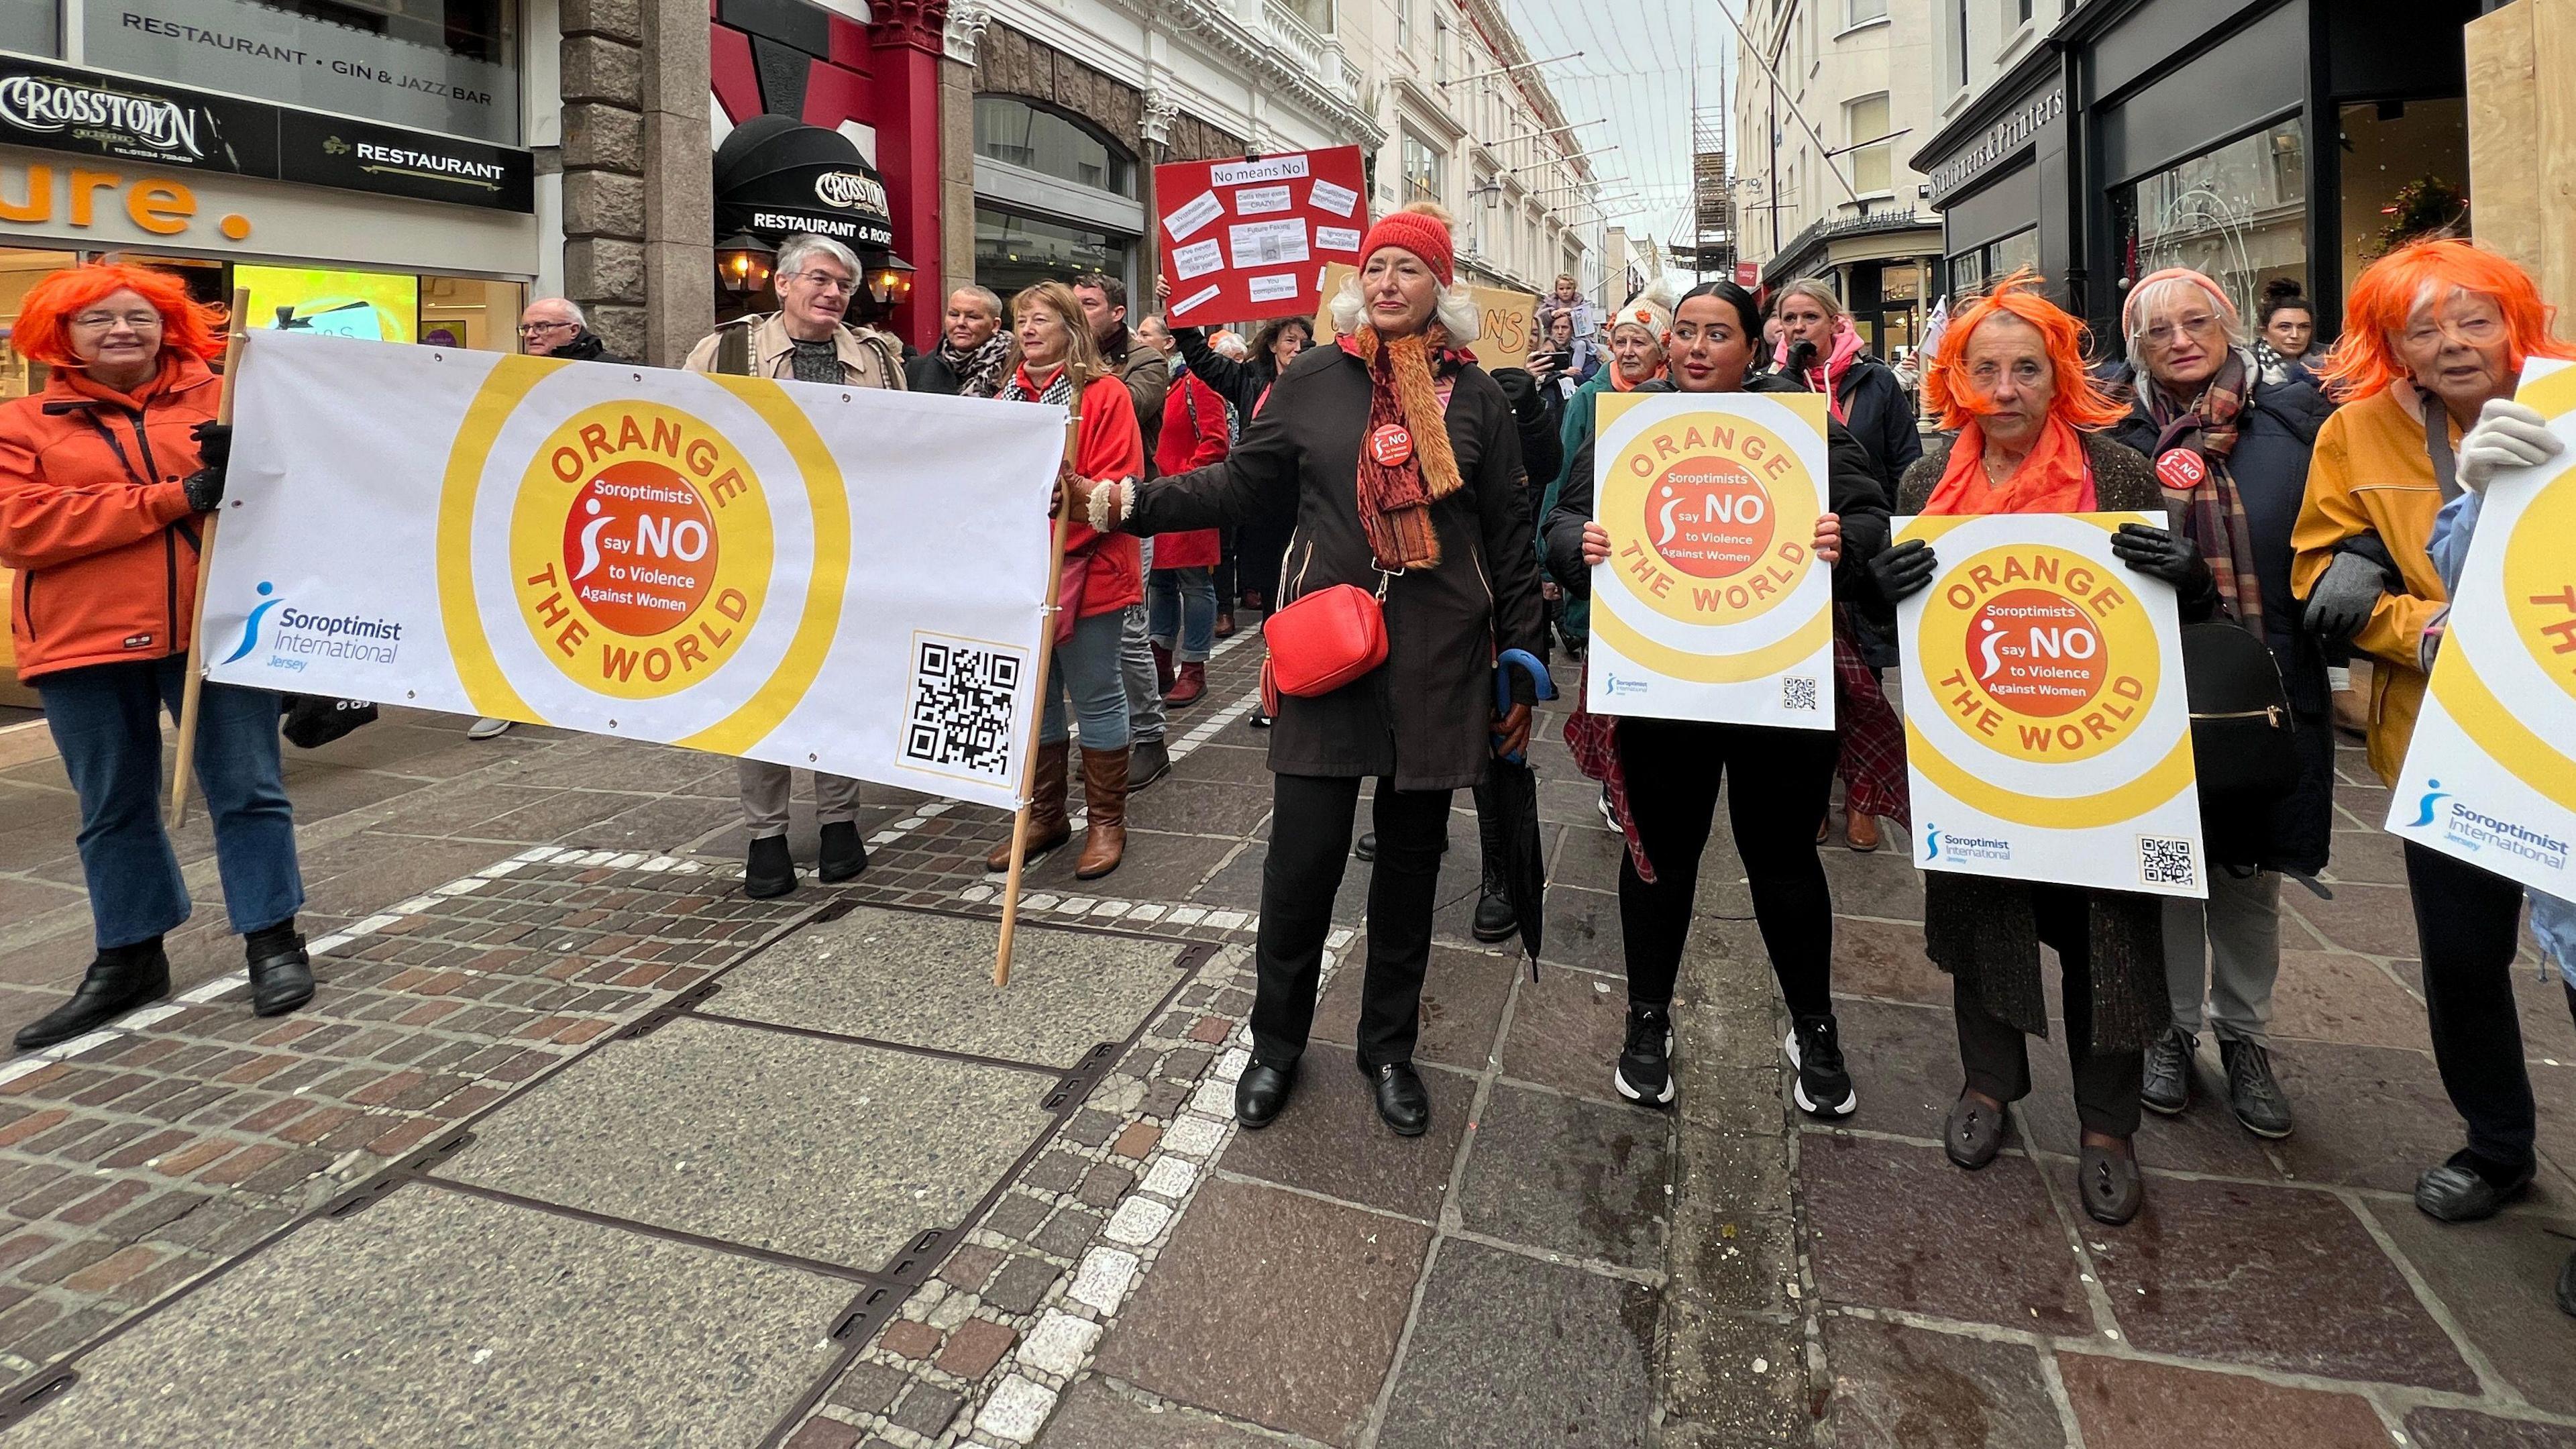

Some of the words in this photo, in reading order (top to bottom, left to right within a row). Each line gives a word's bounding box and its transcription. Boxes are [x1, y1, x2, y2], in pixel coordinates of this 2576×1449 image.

[123, 13, 307, 66] RESTAURANT
[332, 61, 372, 80] GIN
[378, 70, 392, 84] &
[396, 75, 447, 97] JAZZ
[452, 87, 492, 106] BAR
[0, 76, 204, 159] CROSSTOWN
[1931, 144, 1986, 199] Stationers
[1986, 131, 1998, 162] &
[1996, 88, 2064, 156] Printers
[357, 144, 504, 180] RESTAURANT
[1215, 170, 1233, 183] No
[1236, 168, 1279, 180] means
[1282, 161, 1306, 175] No!
[754, 213, 857, 237] RESTAURANT
[859, 226, 869, 239] &
[1173, 203, 1218, 235] communication
[1175, 201, 1205, 222] Withholds
[1388, 432, 1408, 446] NO
[1629, 426, 1792, 481] ORANGE
[551, 415, 747, 508] ORANGE
[2178, 462, 2200, 480] NO
[594, 479, 693, 505] Soroptimists
[1667, 472, 1750, 486] Soroptimists
[1678, 512, 1700, 524] say
[1705, 493, 1765, 525] NO
[604, 537, 632, 554] say
[636, 514, 709, 562] NO
[1685, 532, 1699, 542] to
[1701, 532, 1754, 545] Violence
[1661, 547, 1704, 559] Against
[1706, 550, 1752, 563] Women
[608, 564, 626, 580] to
[629, 565, 696, 589] Violence
[1620, 539, 1676, 599] THE
[1692, 541, 1805, 612] WORLD
[1947, 555, 2125, 618] ORANGE
[580, 585, 633, 604] Against
[636, 592, 687, 612] Women
[1986, 605, 2077, 619] Soroptimists
[279, 607, 403, 641] Soroptimist
[528, 562, 589, 658] THE
[602, 588, 747, 683] WORLD
[273, 630, 398, 664] International
[2001, 645, 2027, 658] say
[2030, 626, 2097, 660] NO
[266, 655, 309, 672] Jersey
[2010, 665, 2027, 678] to
[2027, 665, 2090, 680] Violence
[1988, 682, 2036, 696] Against
[2038, 684, 2088, 697] Women
[1939, 668, 2004, 737] THE
[2017, 676, 2143, 752] WORLD
[1945, 835, 2010, 851] Soroptimist
[2443, 831, 2481, 853] Jersey
[2448, 816, 2567, 871] International
[2451, 802, 2570, 857] Soroptimist
[1945, 845, 2011, 860] International
